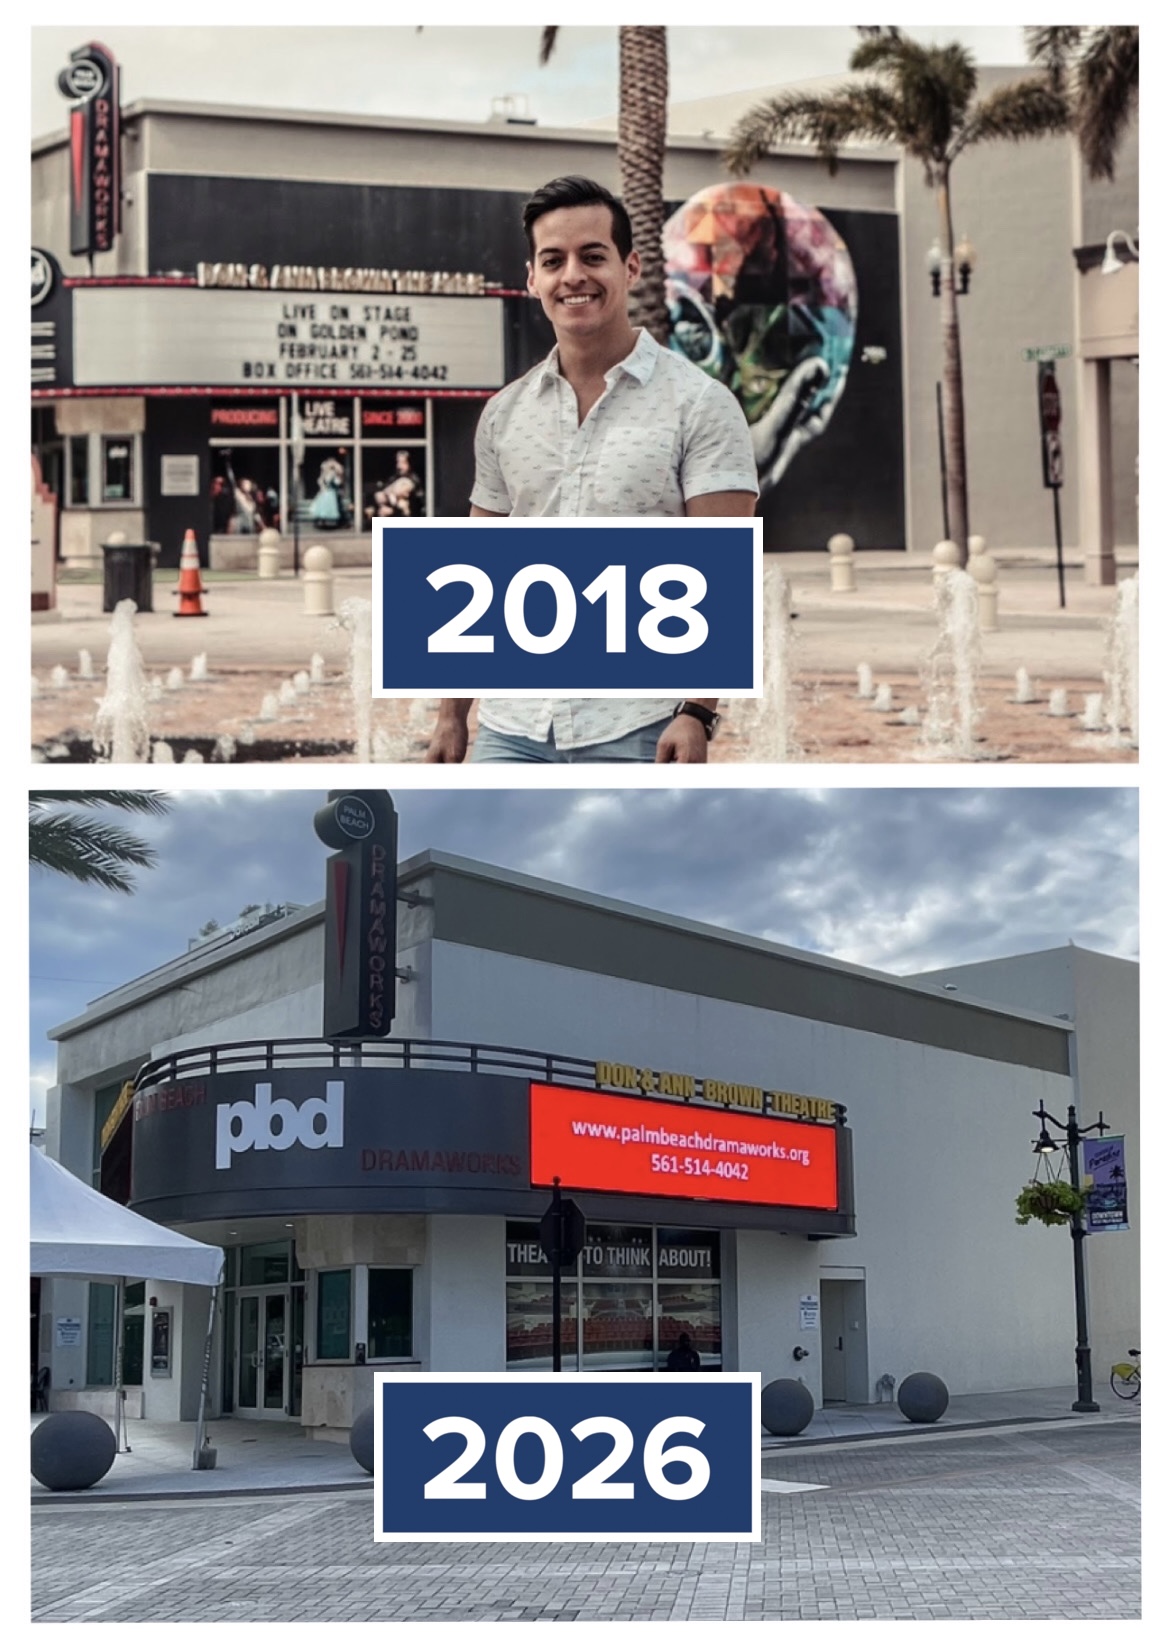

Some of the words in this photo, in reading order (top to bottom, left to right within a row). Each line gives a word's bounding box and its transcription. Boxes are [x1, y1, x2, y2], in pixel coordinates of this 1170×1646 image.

[95, 99, 110, 248] DRAMAWORKS
[282, 304, 315, 320] LIVE
[330, 305, 349, 320] ON
[363, 306, 410, 322] STAGE
[278, 323, 297, 338] ON
[311, 324, 366, 340] GOLDEN
[380, 325, 418, 341] POND
[279, 343, 358, 359] FEBRUARY
[372, 345, 379, 361] 2
[402, 345, 416, 361] 25
[243, 361, 275, 379] BOX
[286, 362, 337, 379] OFFICE
[351, 363, 447, 380] 561-514-4042
[211, 409, 277, 425] PRODUCING
[305, 401, 335, 416] LIVE
[363, 410, 393, 425] SINCE
[343, 804, 366, 818] PALM
[339, 814, 368, 830] BEACH
[367, 844, 387, 1028] DRAMAWORKS
[596, 1061, 637, 1088] DON
[640, 1068, 656, 1092] &
[658, 1071, 696, 1097] ANN
[702, 1079, 764, 1109] BROWN
[769, 1090, 838, 1119] THEATRE
[215, 1080, 345, 1169] pbd
[571, 1120, 810, 1165] www.palmbeachdramaworks.org
[361, 1148, 522, 1176] DRAMAWORKS
[651, 1153, 749, 1180] 561-514-4042
[584, 1245, 603, 1265] TO
[607, 1247, 650, 1266] THINK
[658, 1249, 712, 1267] ABOUT!
